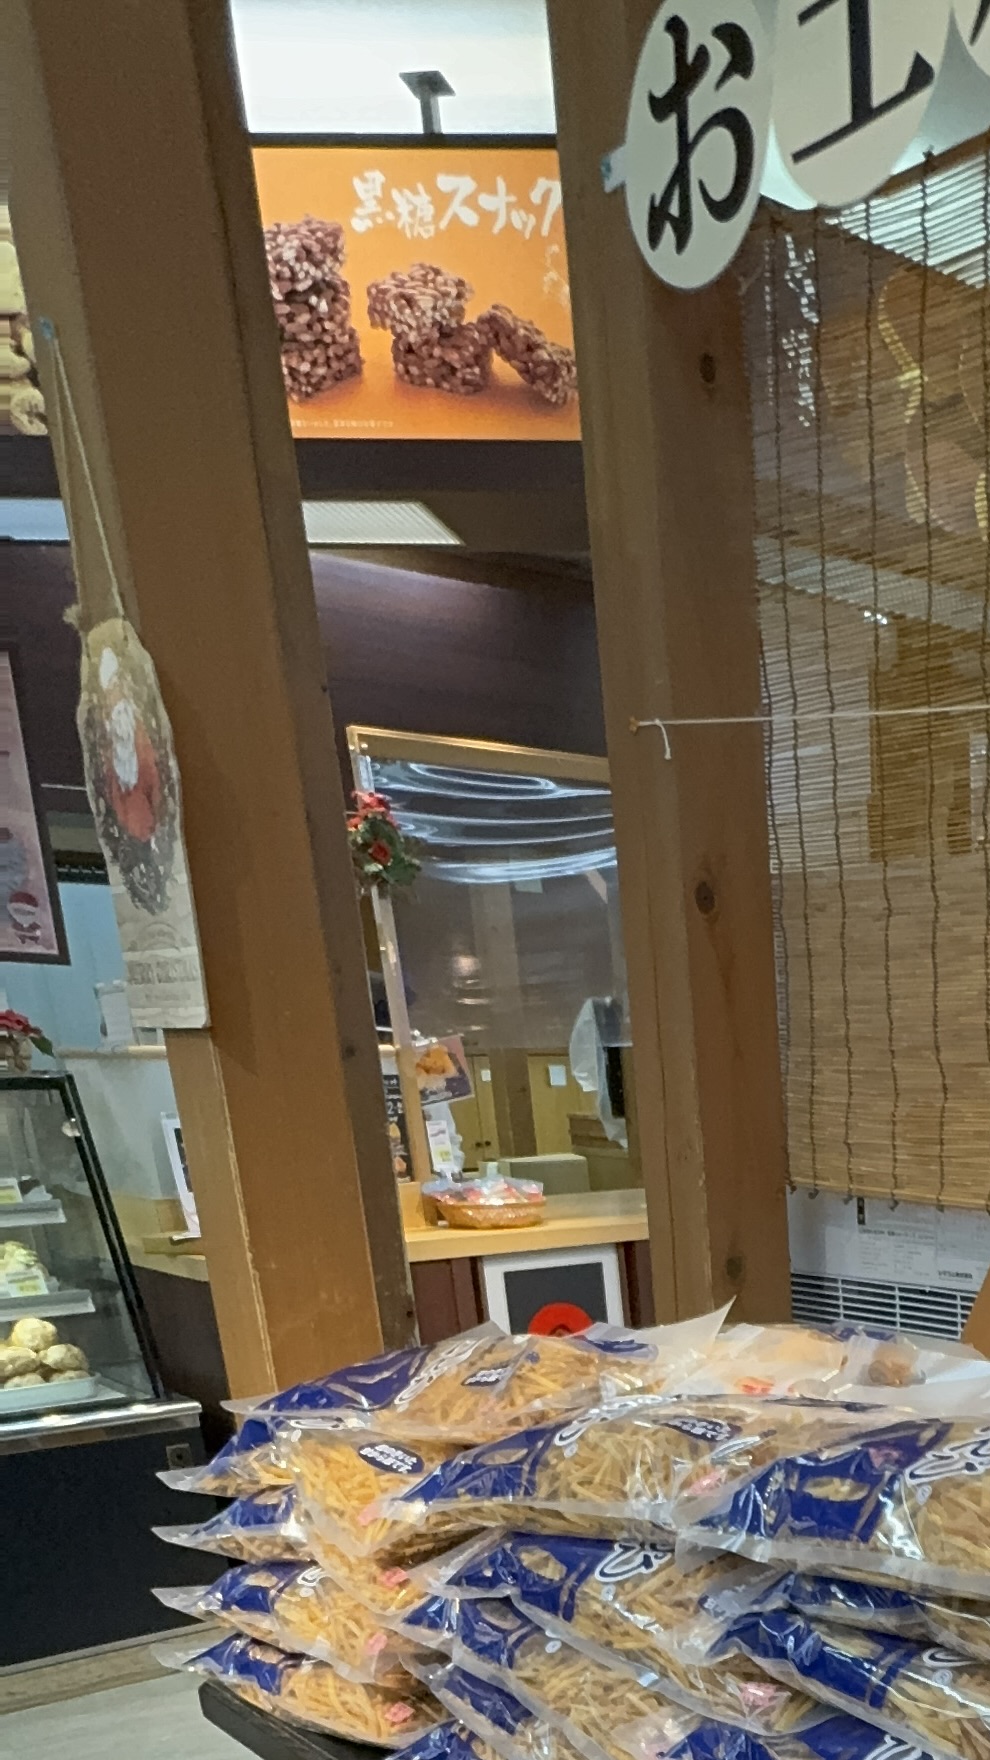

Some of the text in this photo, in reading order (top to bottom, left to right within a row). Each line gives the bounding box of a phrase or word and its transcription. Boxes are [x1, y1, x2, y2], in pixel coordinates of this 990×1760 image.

[350, 168, 563, 240] 黒糖スナック
